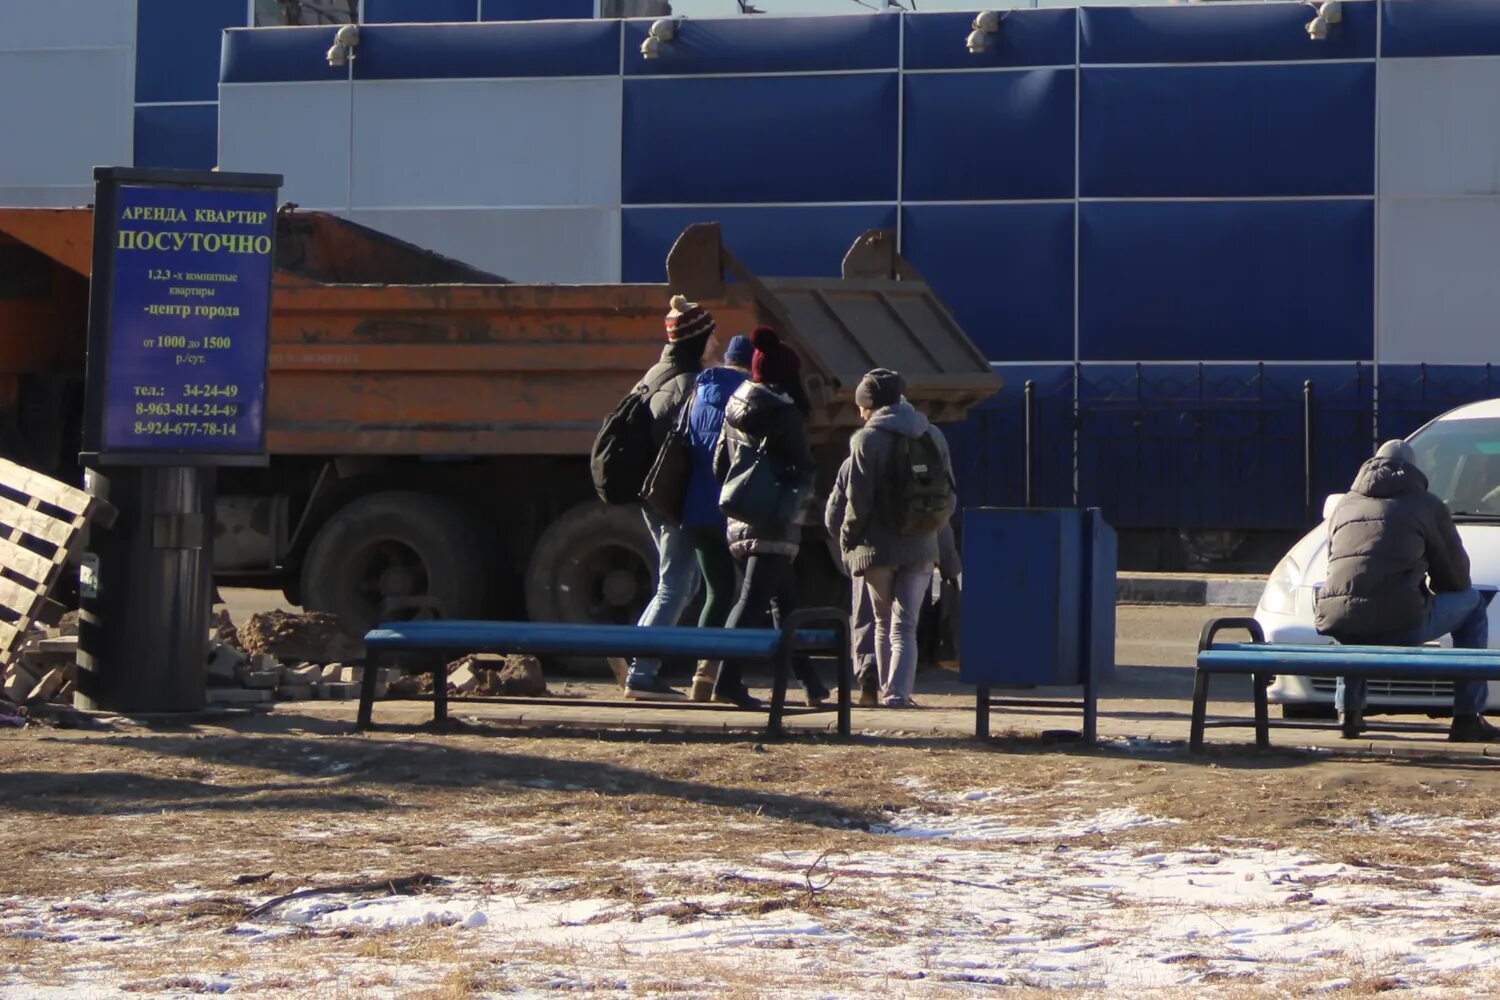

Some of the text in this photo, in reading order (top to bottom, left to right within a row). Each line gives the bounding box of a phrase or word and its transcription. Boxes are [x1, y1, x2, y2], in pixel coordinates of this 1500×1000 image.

[121, 206, 267, 225] АРЕНДА КВАРТИР
[117, 230, 272, 255] ПОСУТОЧНО
[185, 272, 238, 282] комнатные
[169, 286, 215, 298] квартиры
[143, 303, 240, 319] -центр города
[143, 335, 231, 349] от 1000 до 1500
[183, 384, 238, 397] 34-24-49
[135, 402, 238, 417] 8-963-814-24-49
[134, 422, 236, 436] 8-924-677-78-14
